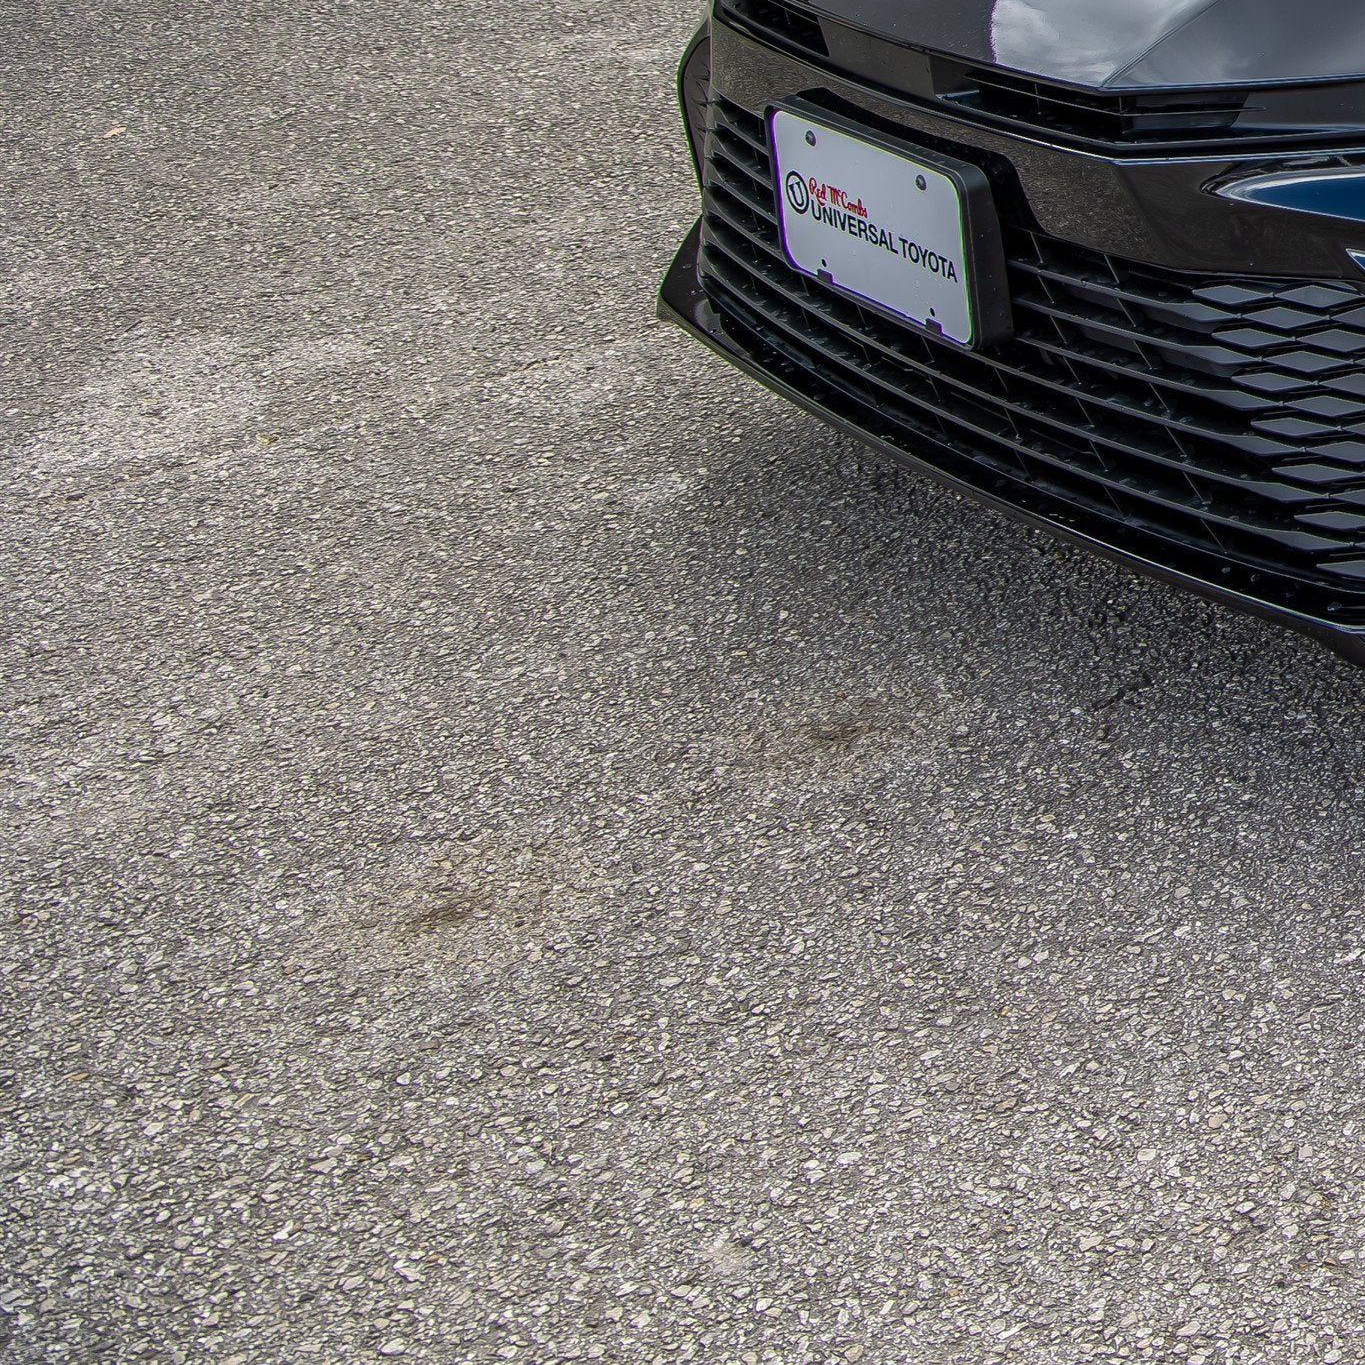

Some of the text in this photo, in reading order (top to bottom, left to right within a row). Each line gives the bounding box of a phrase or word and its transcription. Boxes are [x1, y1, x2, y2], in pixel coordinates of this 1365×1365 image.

[808, 176, 827, 207] Red
[811, 199, 959, 284] UNIVERSAL TOYOTA
